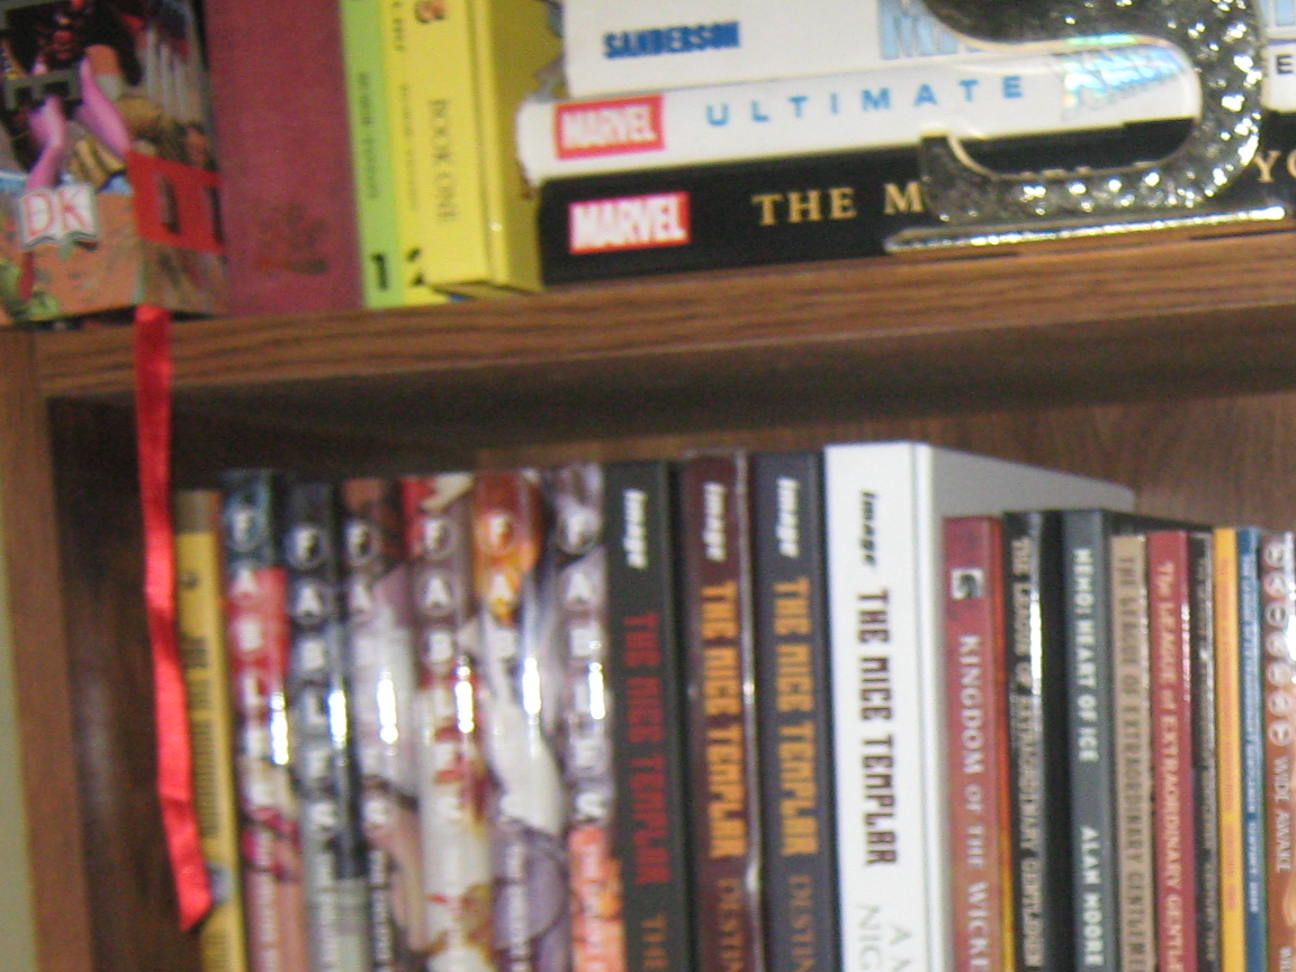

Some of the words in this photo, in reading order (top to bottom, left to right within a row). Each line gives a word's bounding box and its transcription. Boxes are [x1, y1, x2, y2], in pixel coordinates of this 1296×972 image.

[603, 21, 741, 60] SANDERSON
[560, 102, 661, 151] MARVEL
[706, 76, 1025, 127] ULTIMATE
[24, 190, 90, 238] DK
[570, 200, 688, 250] MARVEL
[752, 189, 856, 227] THE
[371, 253, 389, 290] 1
[702, 582, 740, 639] THE
[774, 577, 811, 636] THE
[857, 589, 892, 644] THE
[623, 613, 660, 666] THE
[1075, 619, 1099, 688] HEART
[1158, 601, 1177, 685] LEAGUE
[704, 647, 742, 716] MICE
[775, 644, 815, 712] MICE
[858, 655, 893, 721] MICE
[959, 635, 985, 775] KINGDOM
[627, 677, 664, 743] MICE
[1077, 693, 1099, 723] OF
[1078, 726, 1100, 762] ICE
[707, 723, 746, 859] TEMPLAR
[777, 722, 819, 857] TEMPLAR
[862, 734, 899, 866] TEMPLAR
[1160, 714, 1184, 890] EXTRAORDINARY
[1275, 755, 1292, 804] WIDE
[632, 755, 672, 886] TEMPLAR
[967, 824, 987, 868] THE
[1277, 808, 1294, 874] AWAKE
[1080, 824, 1102, 885] ALAN
[890, 923, 914, 948] A
[1082, 892, 1105, 965] MOORE
